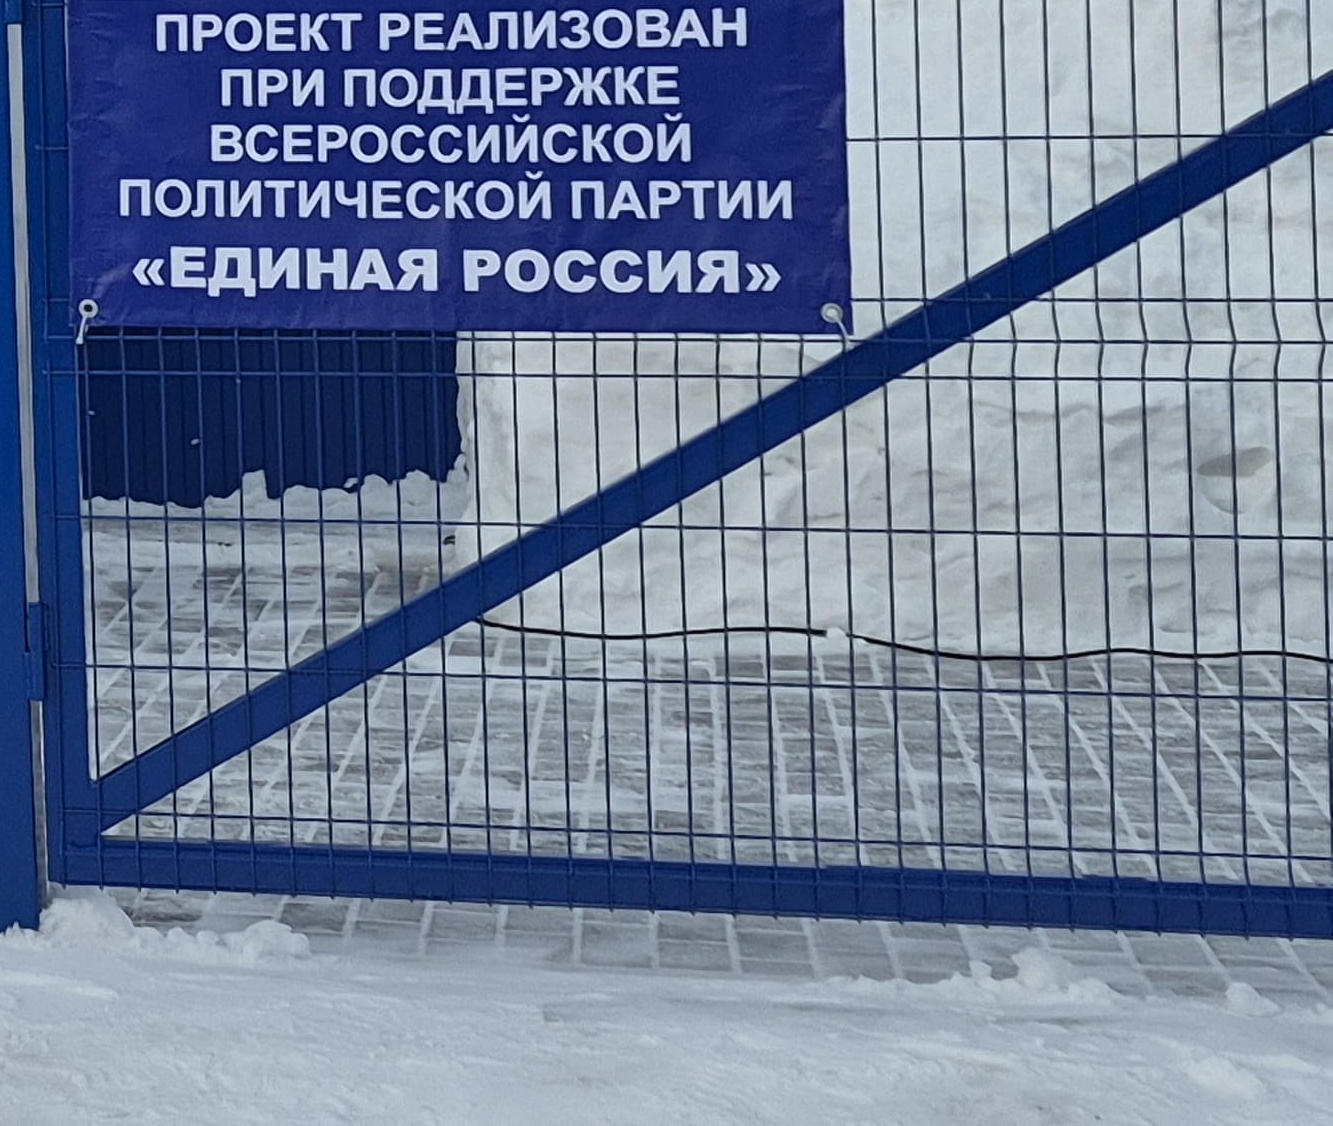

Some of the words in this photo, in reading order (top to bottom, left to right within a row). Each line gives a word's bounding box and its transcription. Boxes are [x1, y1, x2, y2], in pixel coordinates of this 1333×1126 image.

[157, 14, 361, 51] ПРОЕКТ
[380, 8, 746, 50] РЕАЛИЗОВАН
[222, 70, 324, 106] ПРИ
[345, 67, 681, 114] ПОДДЕРЖКЕ
[212, 114, 690, 162] ВСЕРОССИЙСКОЙ
[121, 171, 551, 219] ПОЛИТИЧЕСКОЙ
[572, 181, 792, 219] ПАРТИИ
[133, 247, 437, 296] «ЕДИНАЯ
[464, 249, 780, 292] РОССИЯ»
